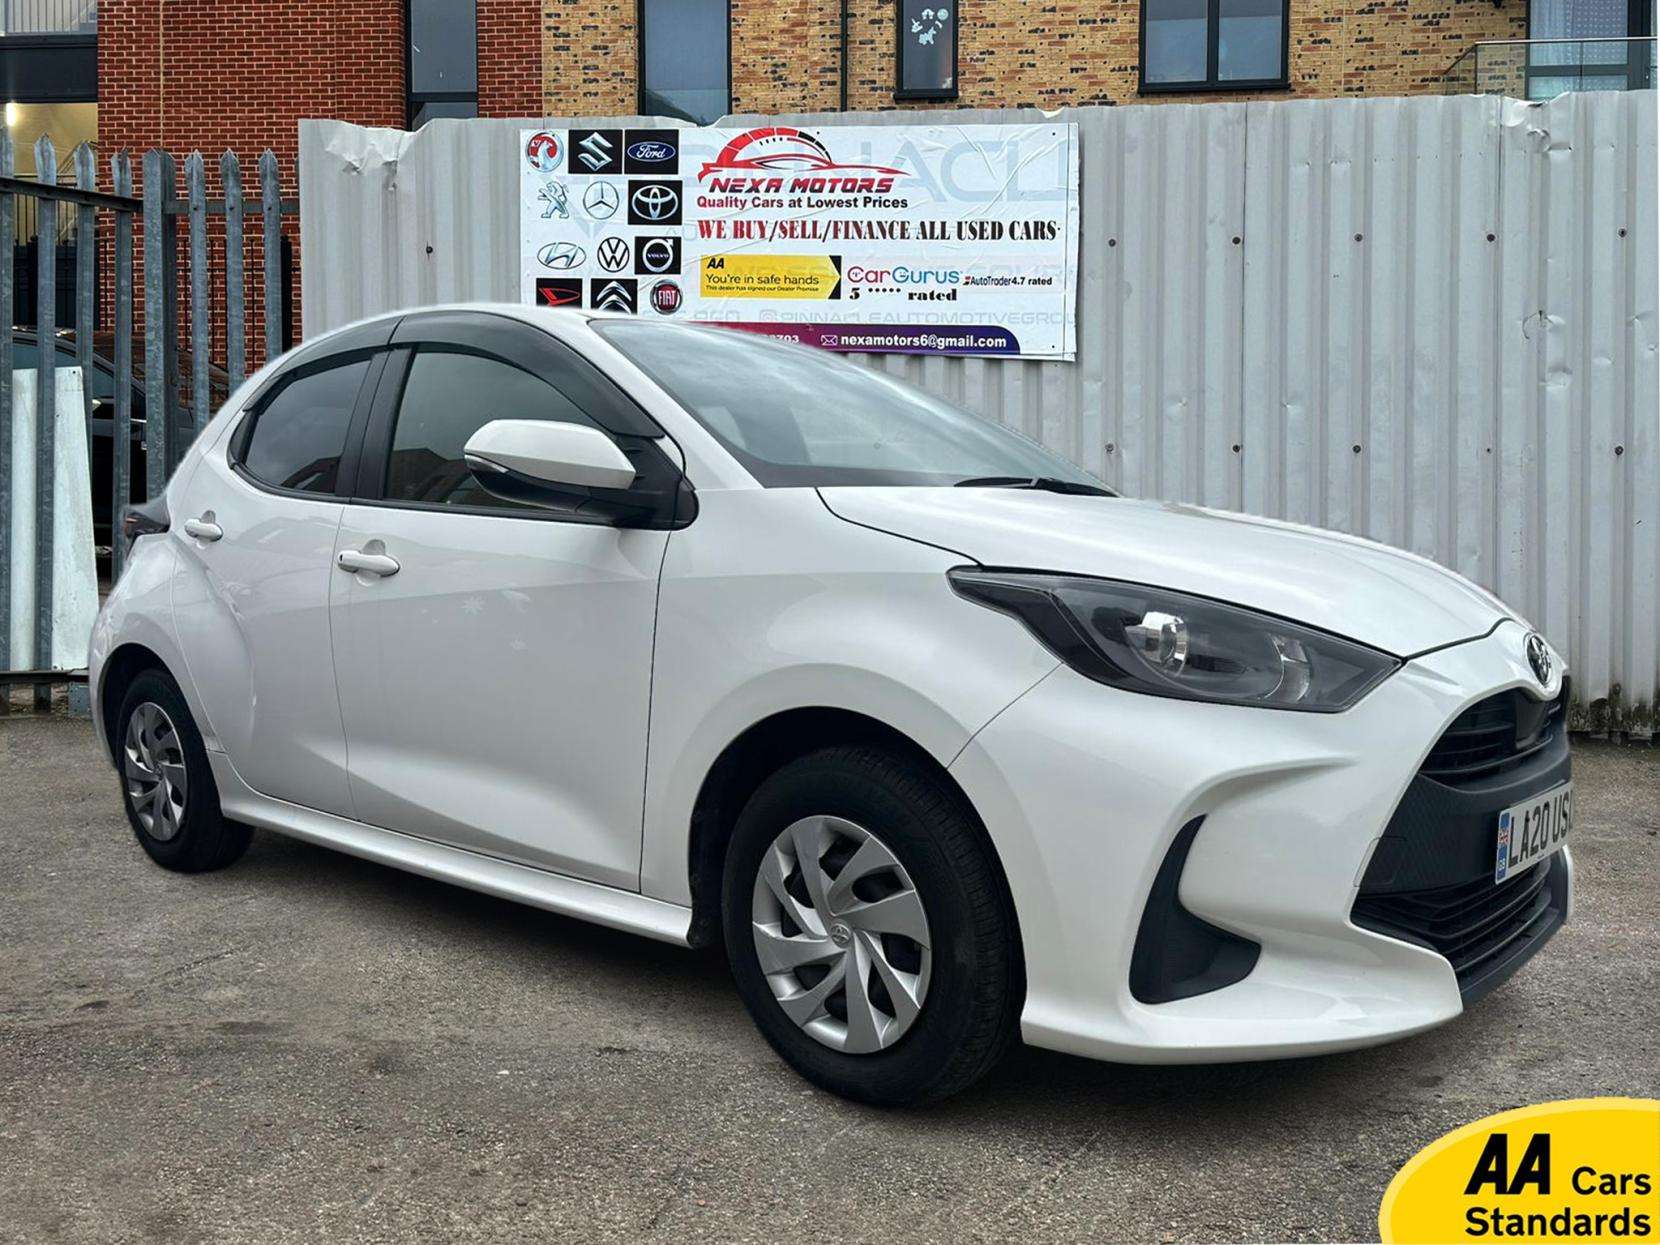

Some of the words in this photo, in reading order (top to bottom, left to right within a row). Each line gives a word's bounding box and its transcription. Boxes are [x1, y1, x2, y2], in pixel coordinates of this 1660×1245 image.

[636, 144, 666, 159] Ford
[709, 178, 784, 193] NEXA
[789, 178, 894, 193] MOTORS
[697, 196, 747, 210] Quality
[751, 197, 783, 208] Cars
[788, 197, 802, 208] at
[807, 196, 858, 209] Lowest
[863, 196, 908, 208] Prices
[697, 220, 727, 240] WE
[916, 221, 951, 240] ALL
[956, 221, 1003, 241] USED
[1008, 221, 1057, 241] CARS
[707, 257, 725, 269] AA
[706, 273, 741, 284] You're
[744, 273, 754, 284] in
[757, 274, 780, 284] safe
[784, 275, 820, 285] hands
[847, 266, 960, 284] CarGurus
[1028, 276, 1053, 286] rated
[658, 290, 677, 305] FIAT
[849, 288, 861, 300] 5
[908, 289, 957, 301] rated
[841, 334, 1007, 349] nexamotors6@gmail.com
[1508, 801, 1550, 868] LA20
